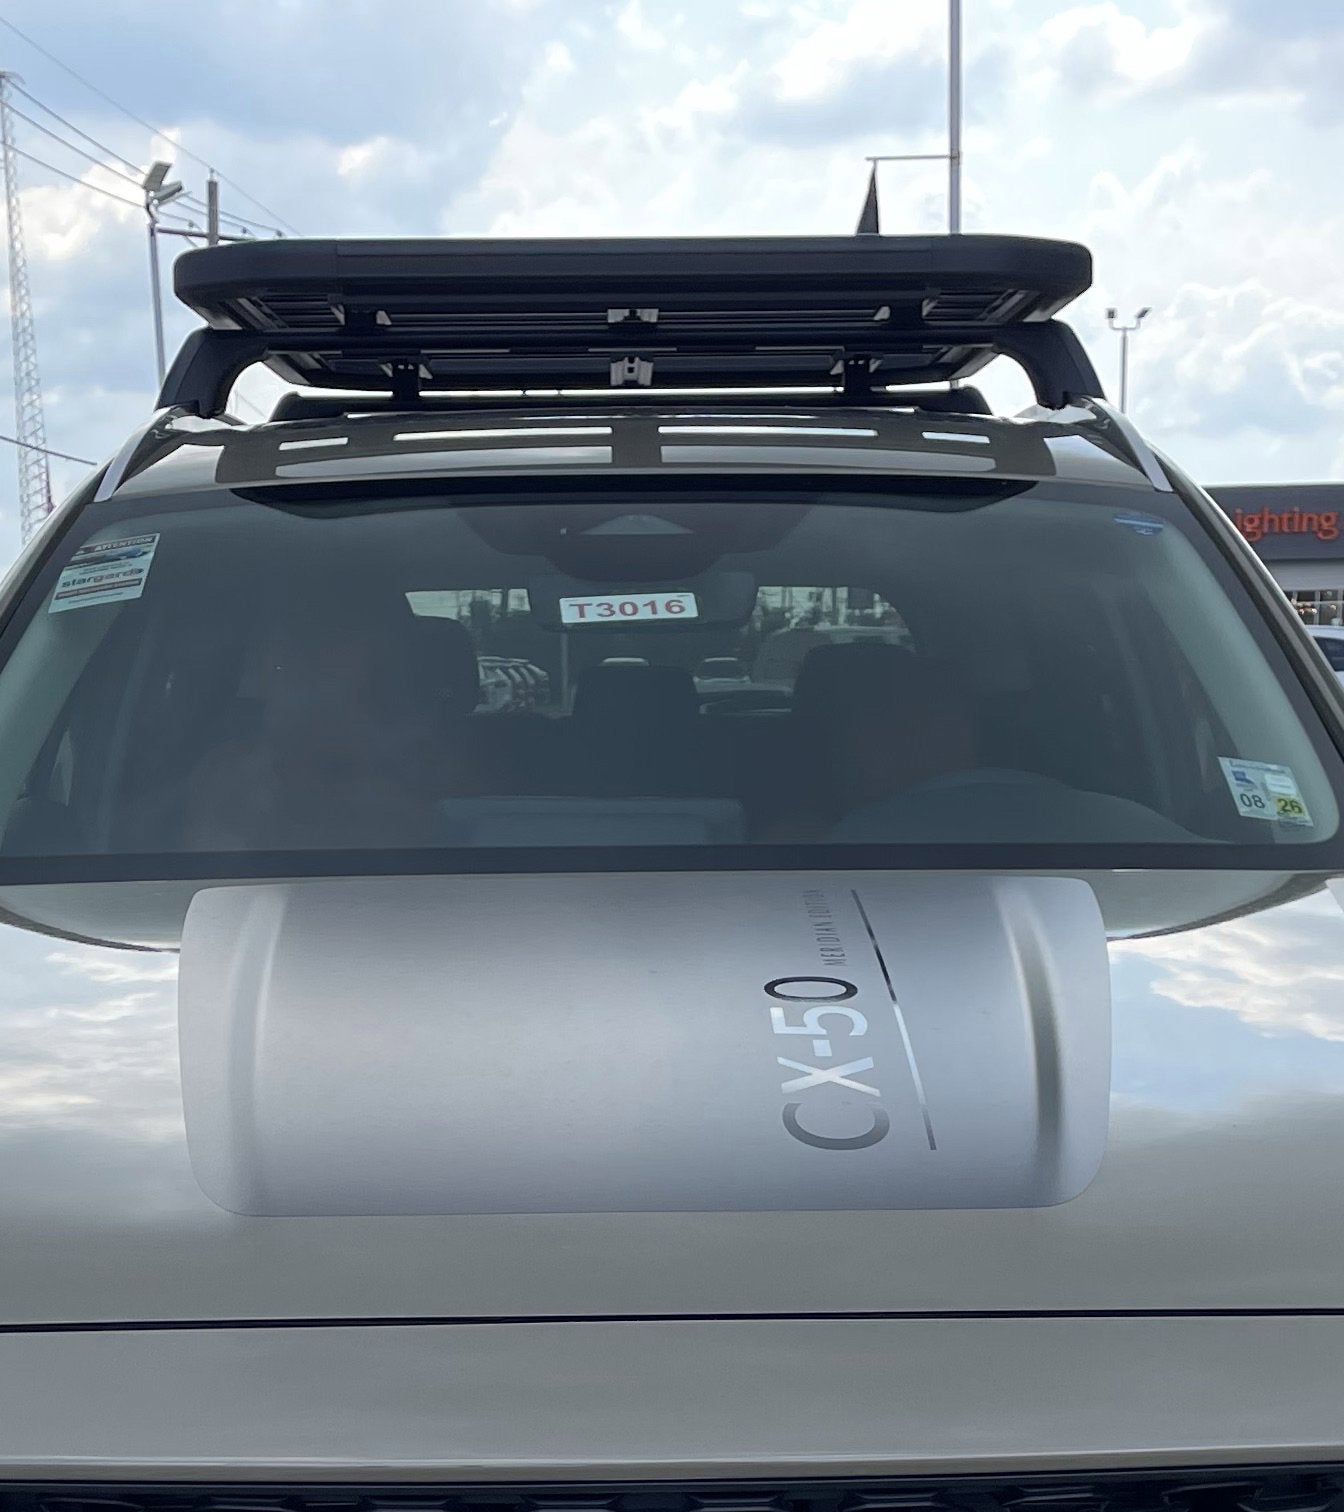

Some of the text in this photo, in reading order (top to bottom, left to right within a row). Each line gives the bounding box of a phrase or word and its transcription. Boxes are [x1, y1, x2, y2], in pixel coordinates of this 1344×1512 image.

[1234, 506, 1339, 542] ighting
[568, 599, 687, 619] T3016
[1240, 793, 1303, 814] 08 26
[812, 920, 848, 967] MERIDIAN
[763, 976, 891, 1151] CX-50
